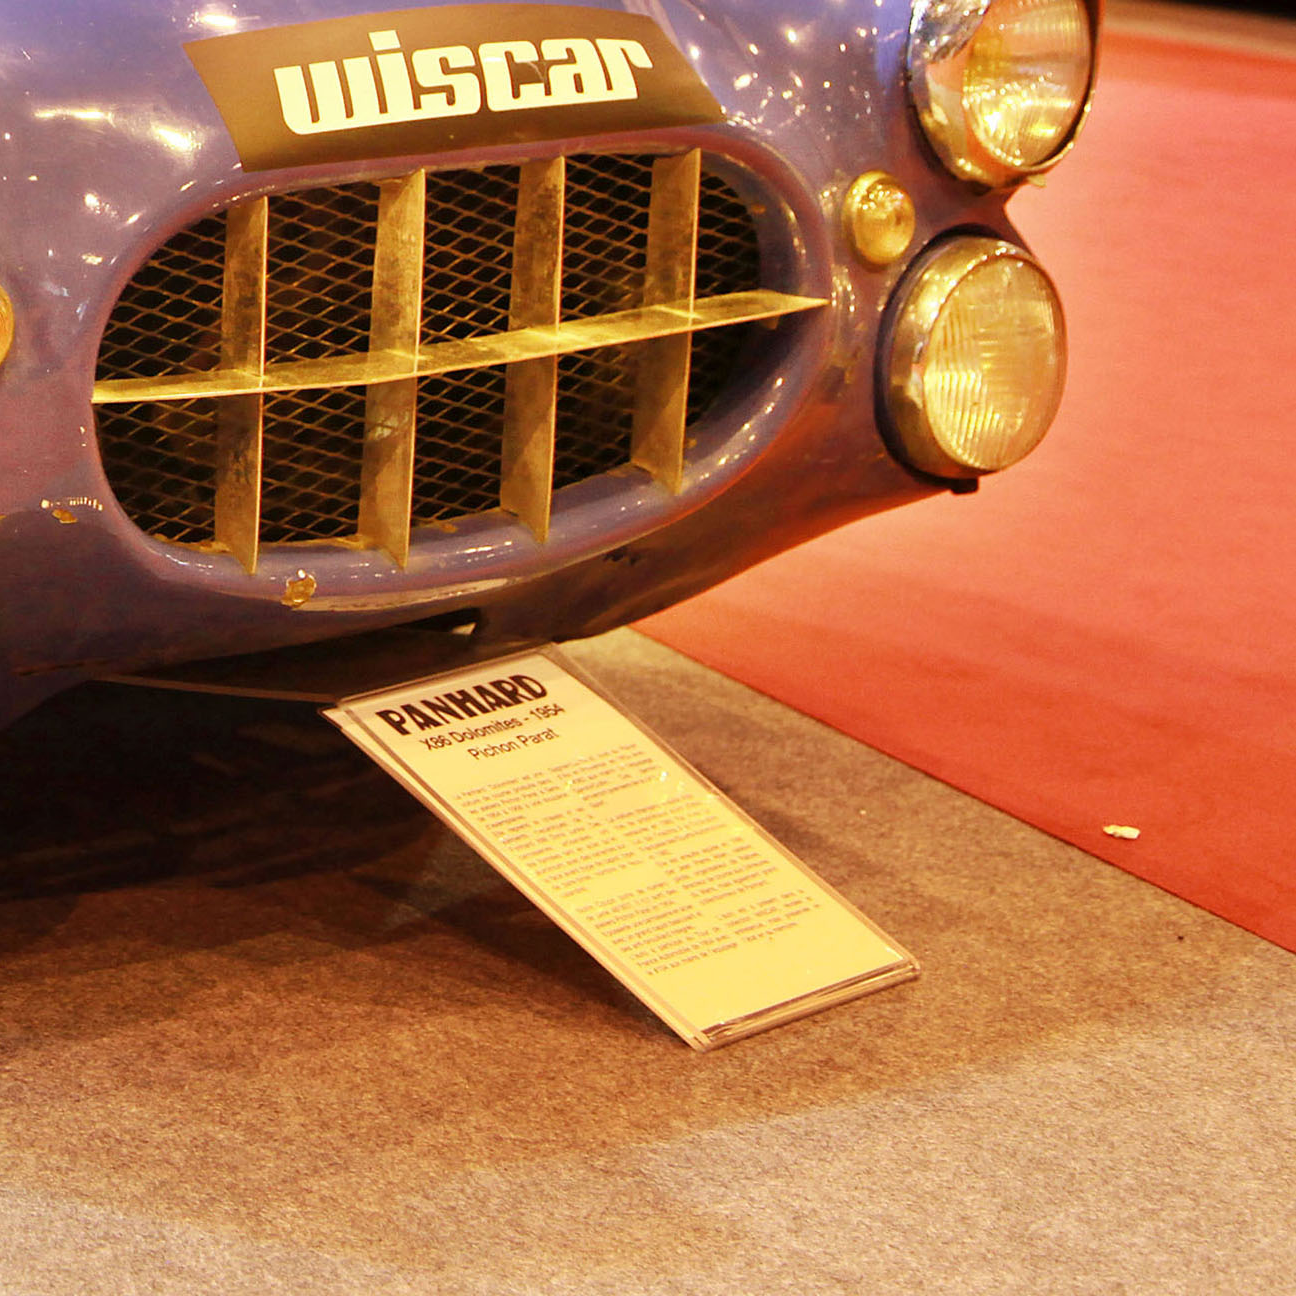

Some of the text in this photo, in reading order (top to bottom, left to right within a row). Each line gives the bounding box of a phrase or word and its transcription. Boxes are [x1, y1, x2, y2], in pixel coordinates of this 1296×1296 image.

[375, 675, 548, 736] PANHARD
[419, 735, 453, 751] X86
[450, 716, 523, 743] Dolomites
[529, 703, 566, 721] 1954
[467, 727, 560, 760] Pichon Parat
